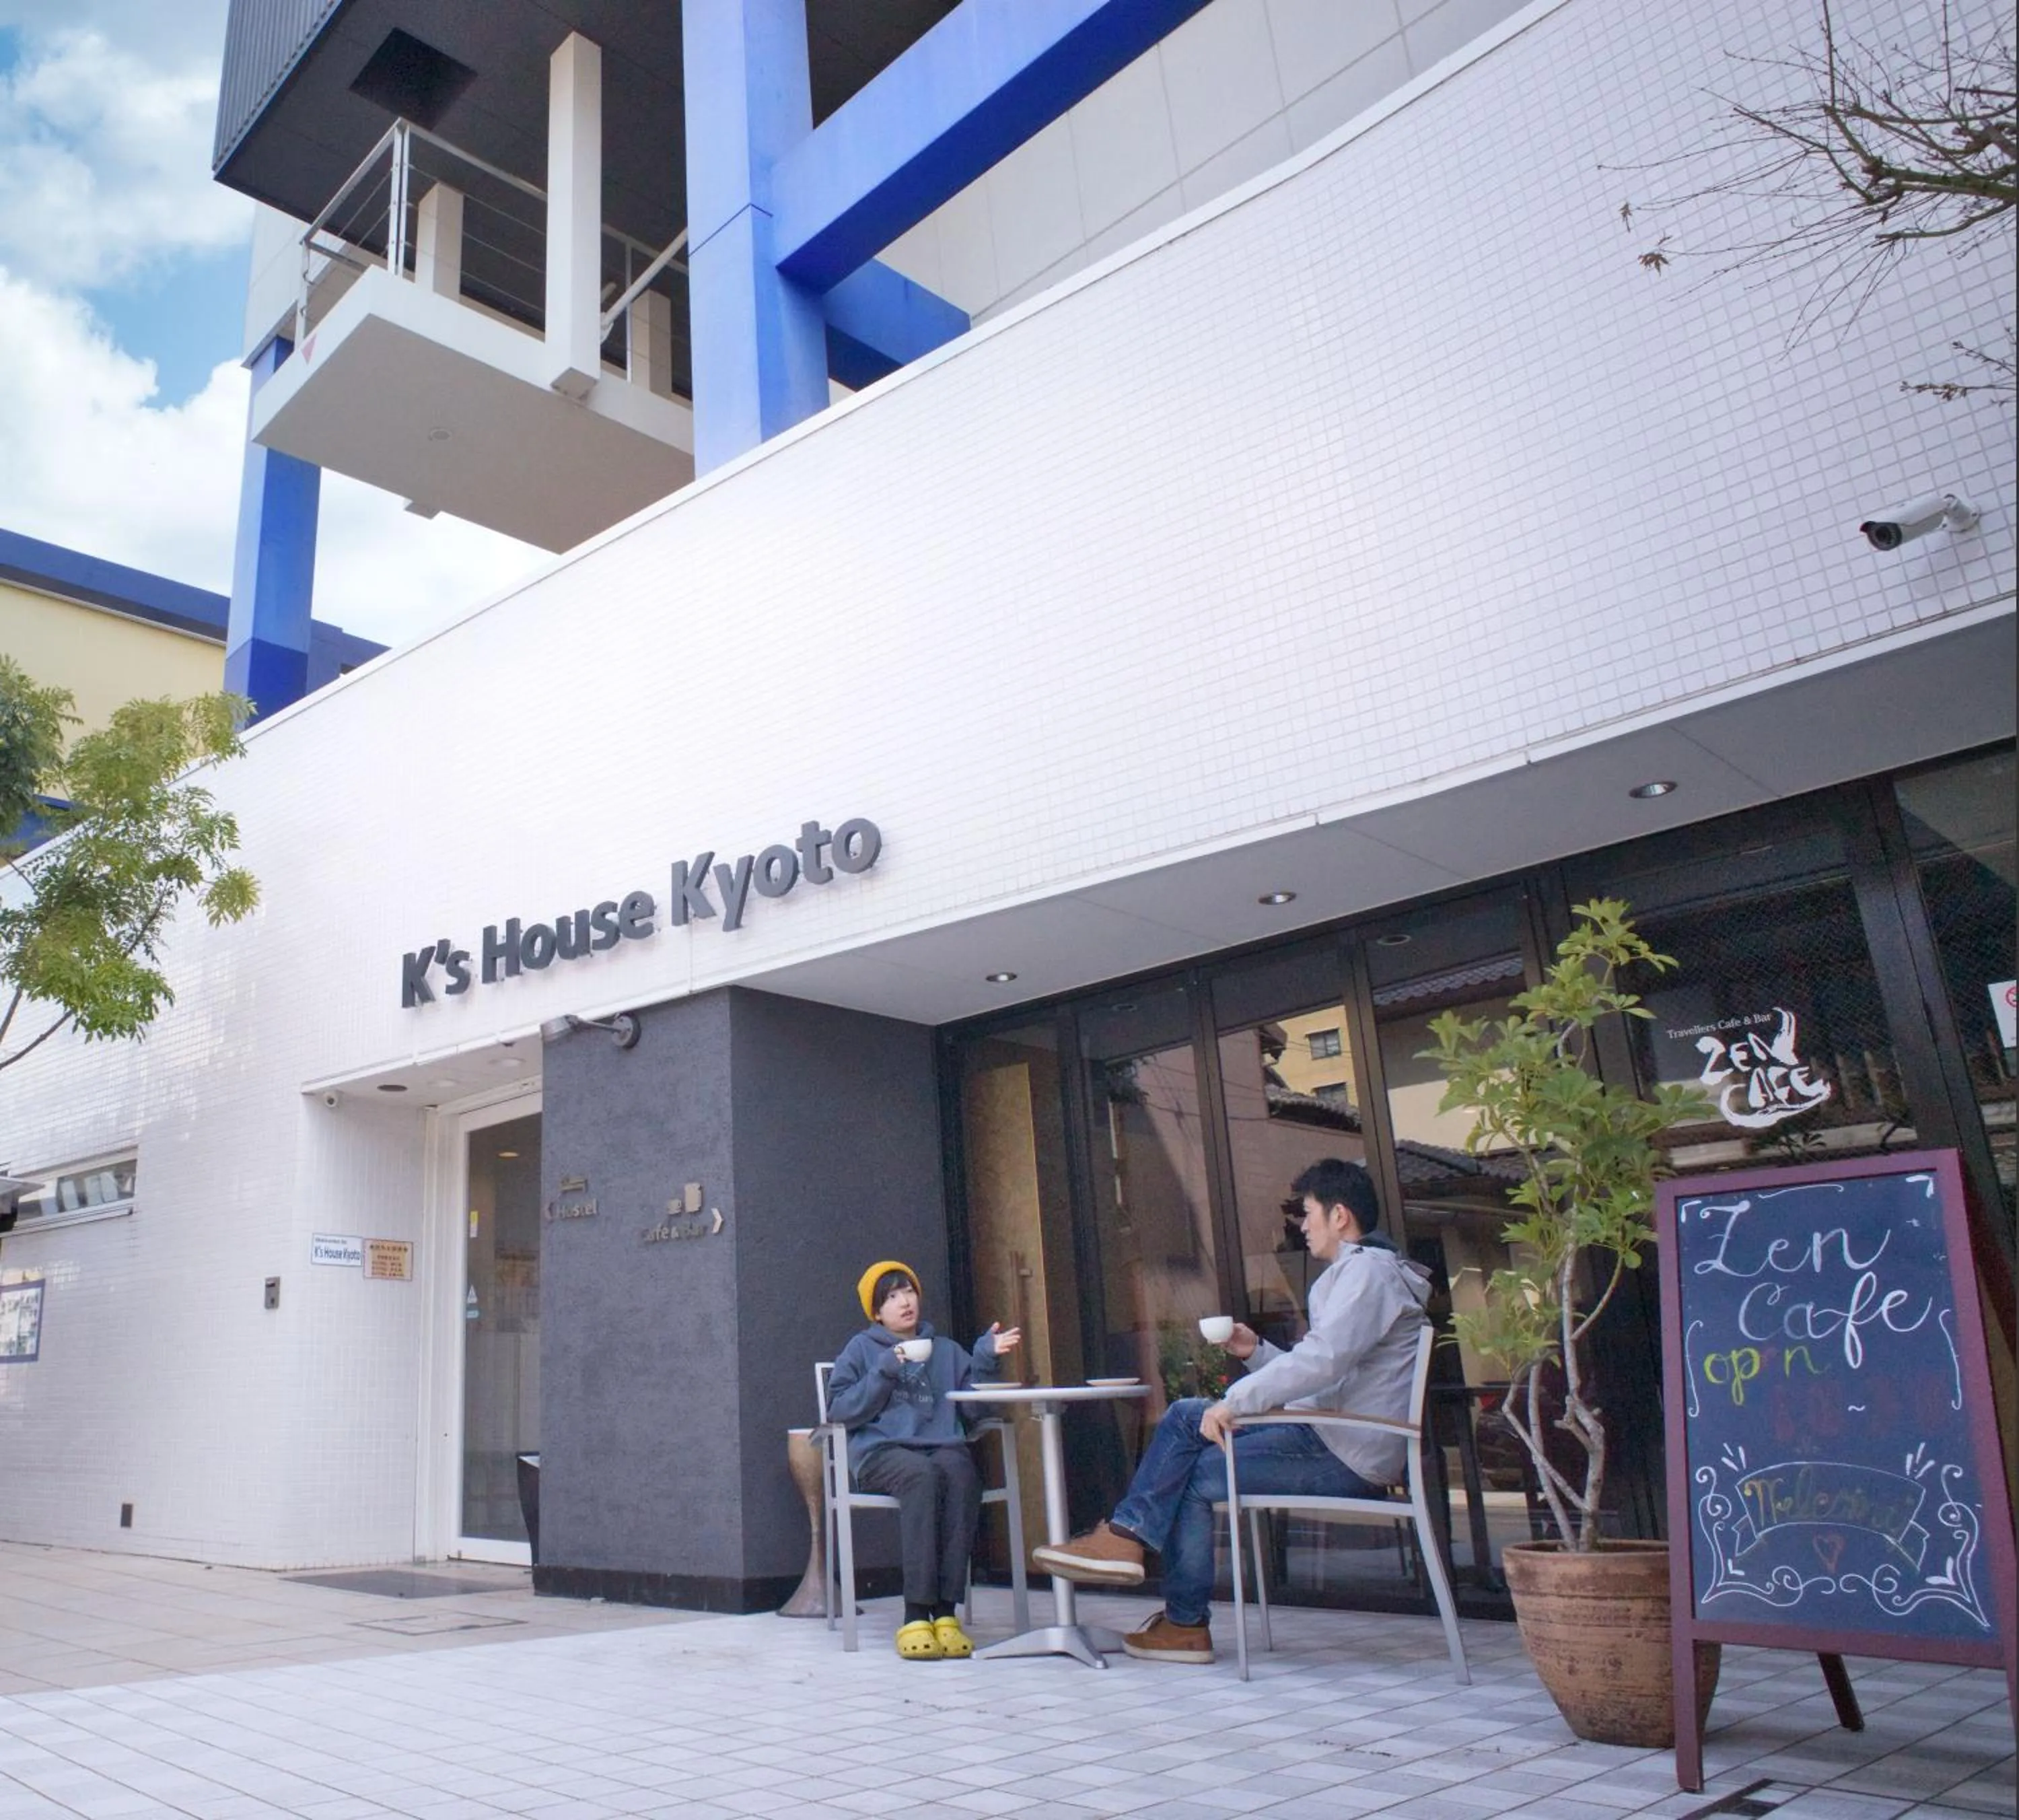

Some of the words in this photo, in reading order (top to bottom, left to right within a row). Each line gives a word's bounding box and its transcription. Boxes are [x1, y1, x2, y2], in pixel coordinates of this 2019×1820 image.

[402, 938, 471, 1008] K's
[481, 890, 656, 984] House
[671, 818, 882, 932] Kyoto
[1667, 1023, 1717, 1039] Travellers
[1717, 1017, 1742, 1029] Cafe
[1744, 1015, 1751, 1025] &
[1753, 1013, 1772, 1024] Bar
[557, 1198, 598, 1218] Hostel
[1694, 1200, 1890, 1278] Zen
[1738, 1271, 1933, 1369] Cafe
[1703, 1346, 1831, 1405] opn
